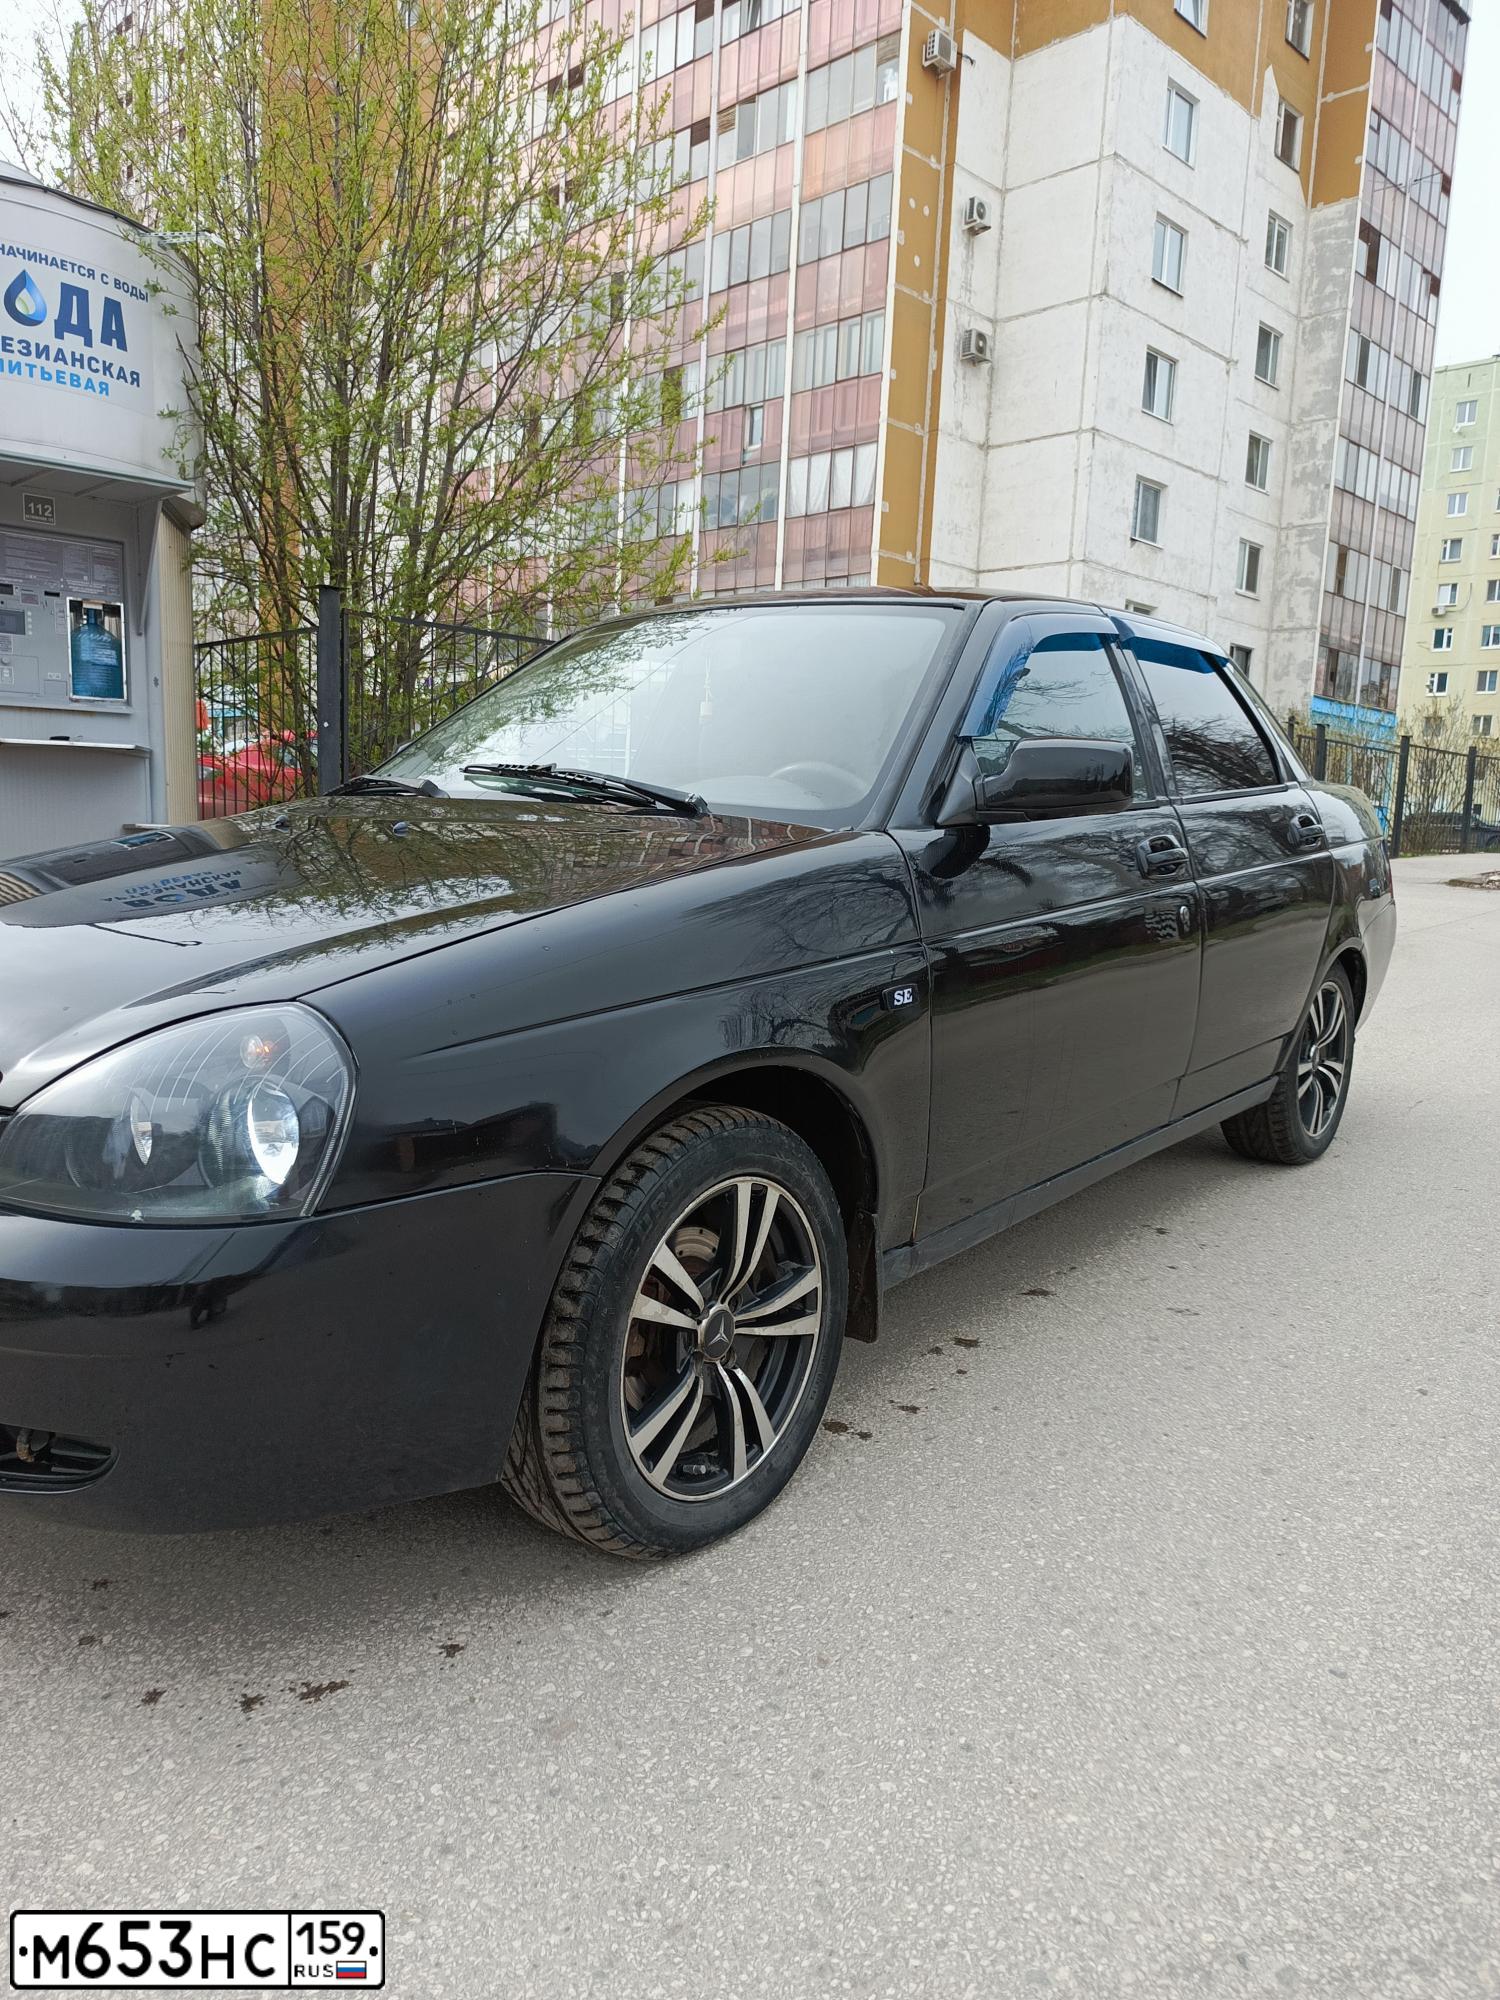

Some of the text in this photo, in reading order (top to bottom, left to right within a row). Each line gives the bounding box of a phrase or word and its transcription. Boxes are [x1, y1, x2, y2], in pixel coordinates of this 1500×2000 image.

[100, 273, 109, 285] С
[114, 277, 149, 302] ВОДЫ
[28, 502, 52, 516] 112
[894, 988, 913, 1005] SE
